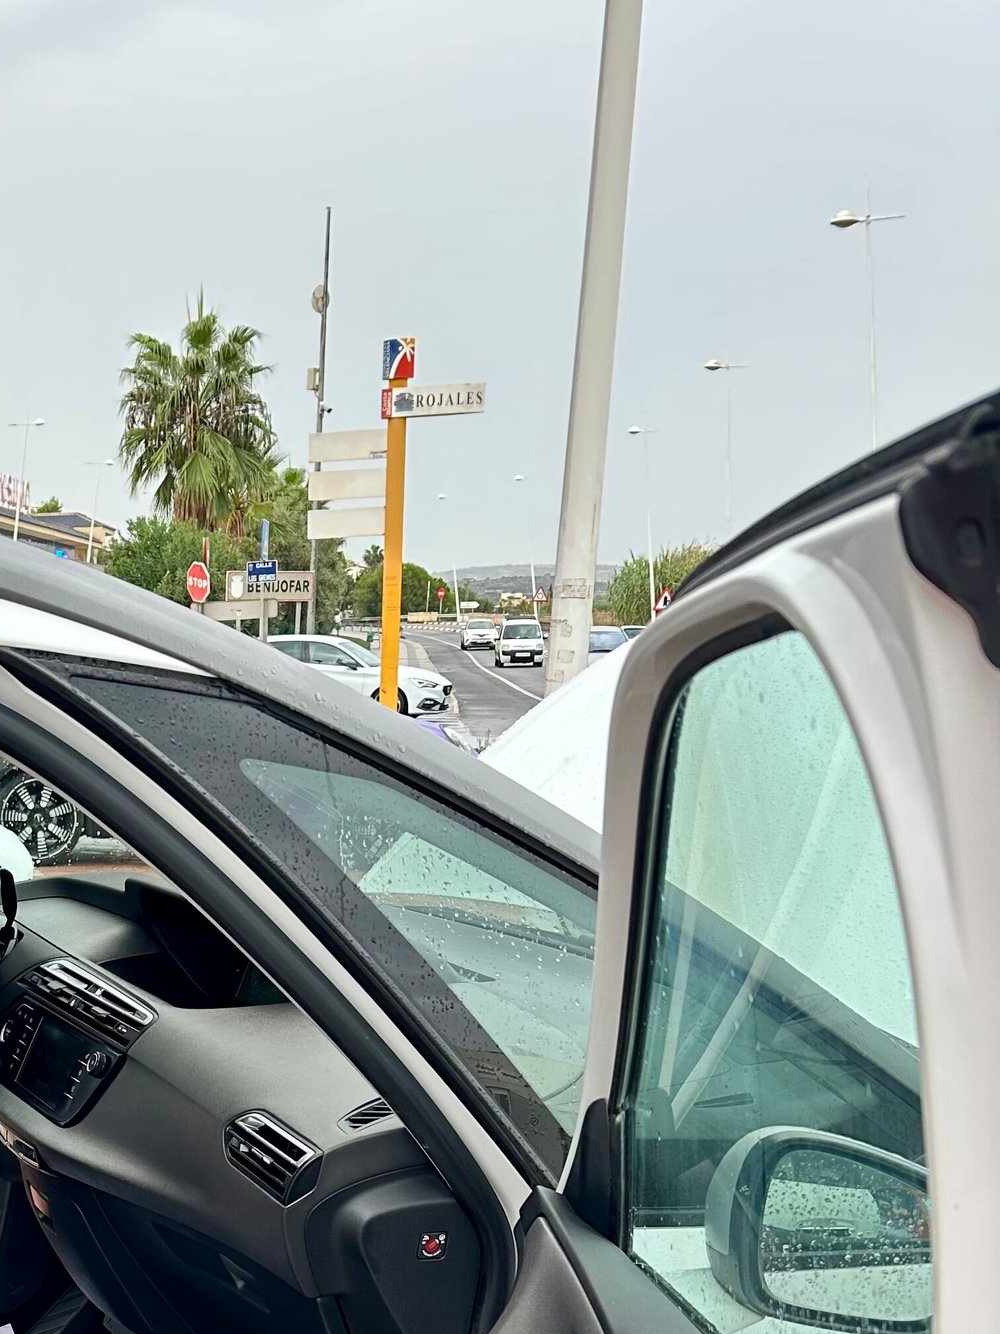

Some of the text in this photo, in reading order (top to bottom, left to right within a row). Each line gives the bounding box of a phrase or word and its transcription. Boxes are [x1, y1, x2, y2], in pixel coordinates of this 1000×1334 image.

[416, 391, 483, 408] ROJALES
[188, 576, 208, 589] STOP
[247, 580, 310, 593] BENIJOFAR
